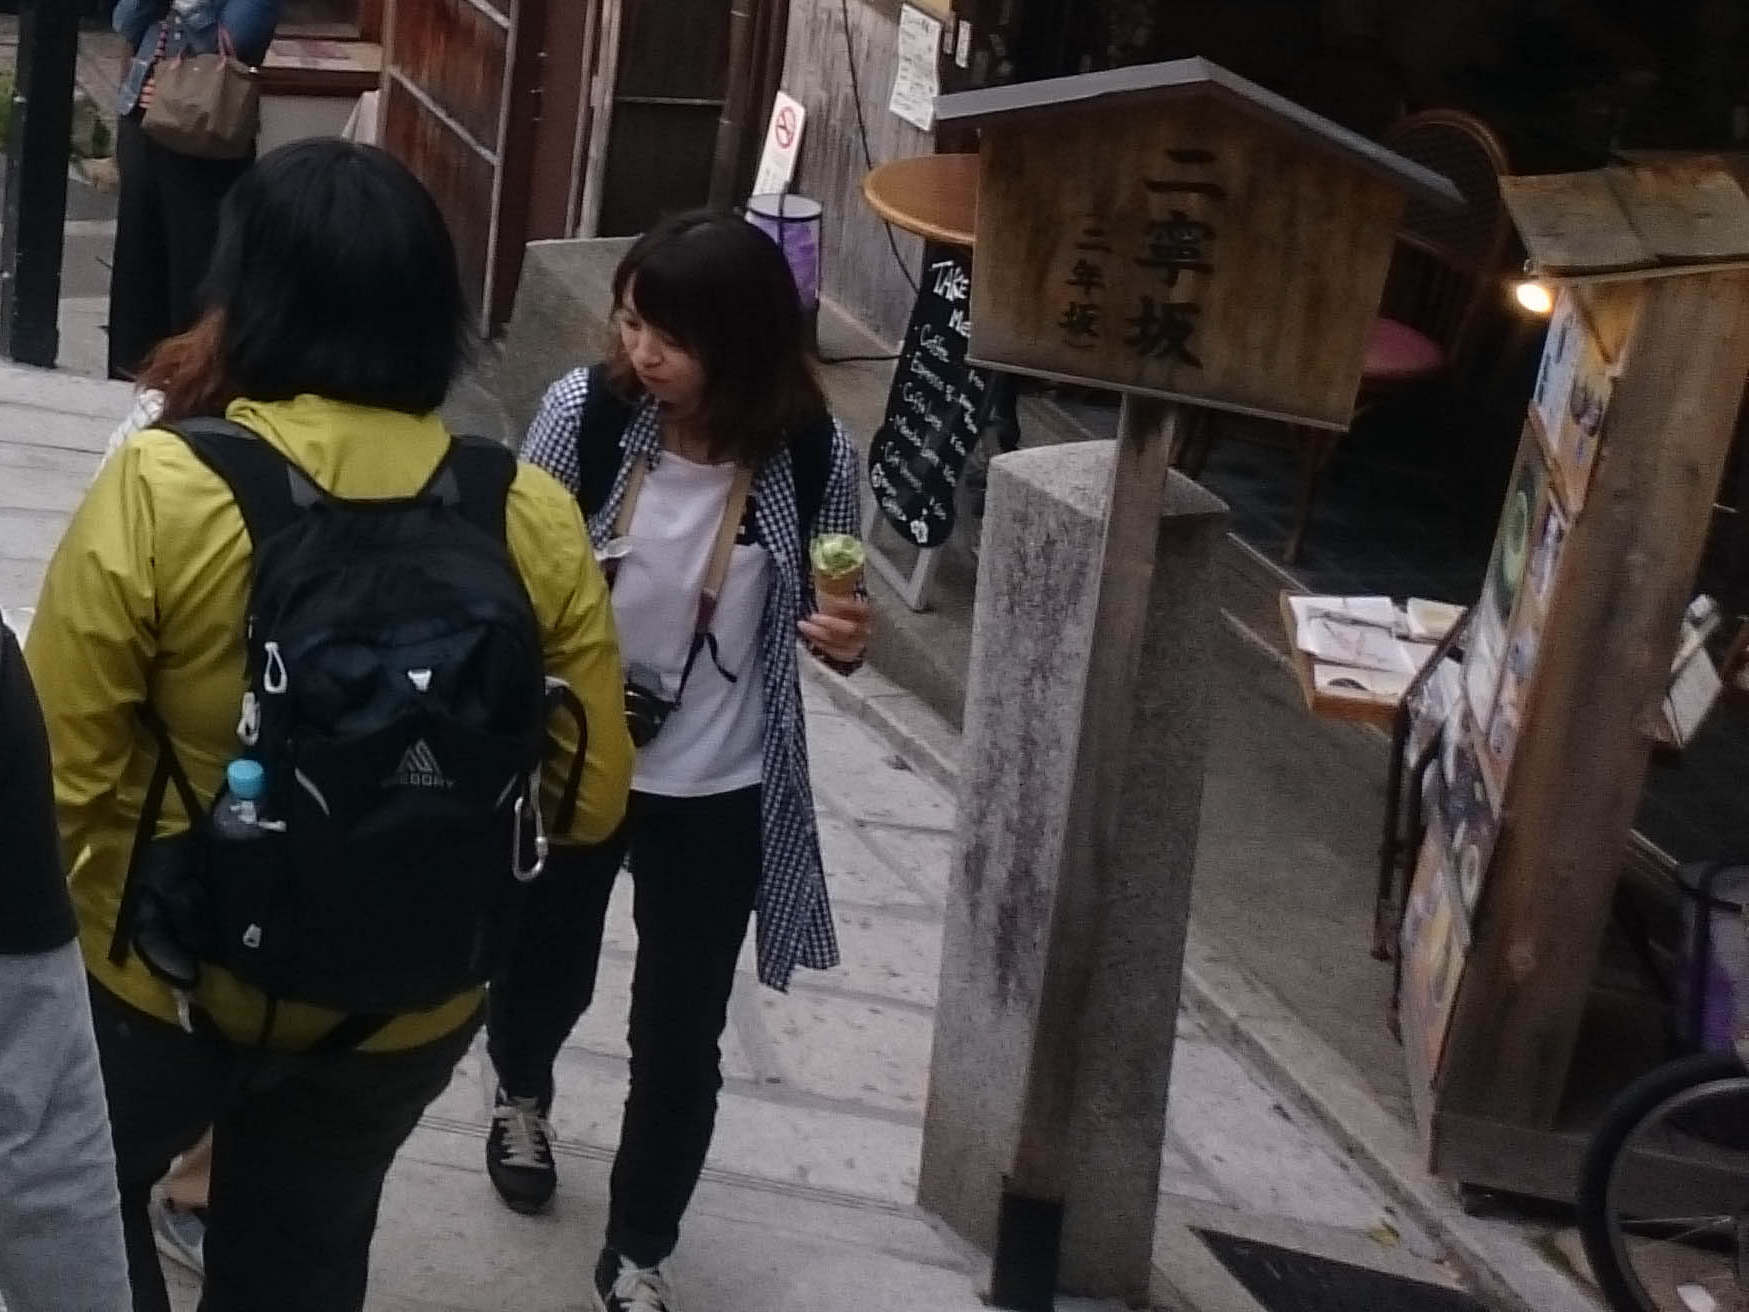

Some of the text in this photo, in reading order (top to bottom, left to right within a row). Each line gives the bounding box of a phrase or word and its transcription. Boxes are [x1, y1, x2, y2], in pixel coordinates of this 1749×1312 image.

[931, 260, 969, 302] TAKE
[1122, 148, 1228, 369] 二寧坂
